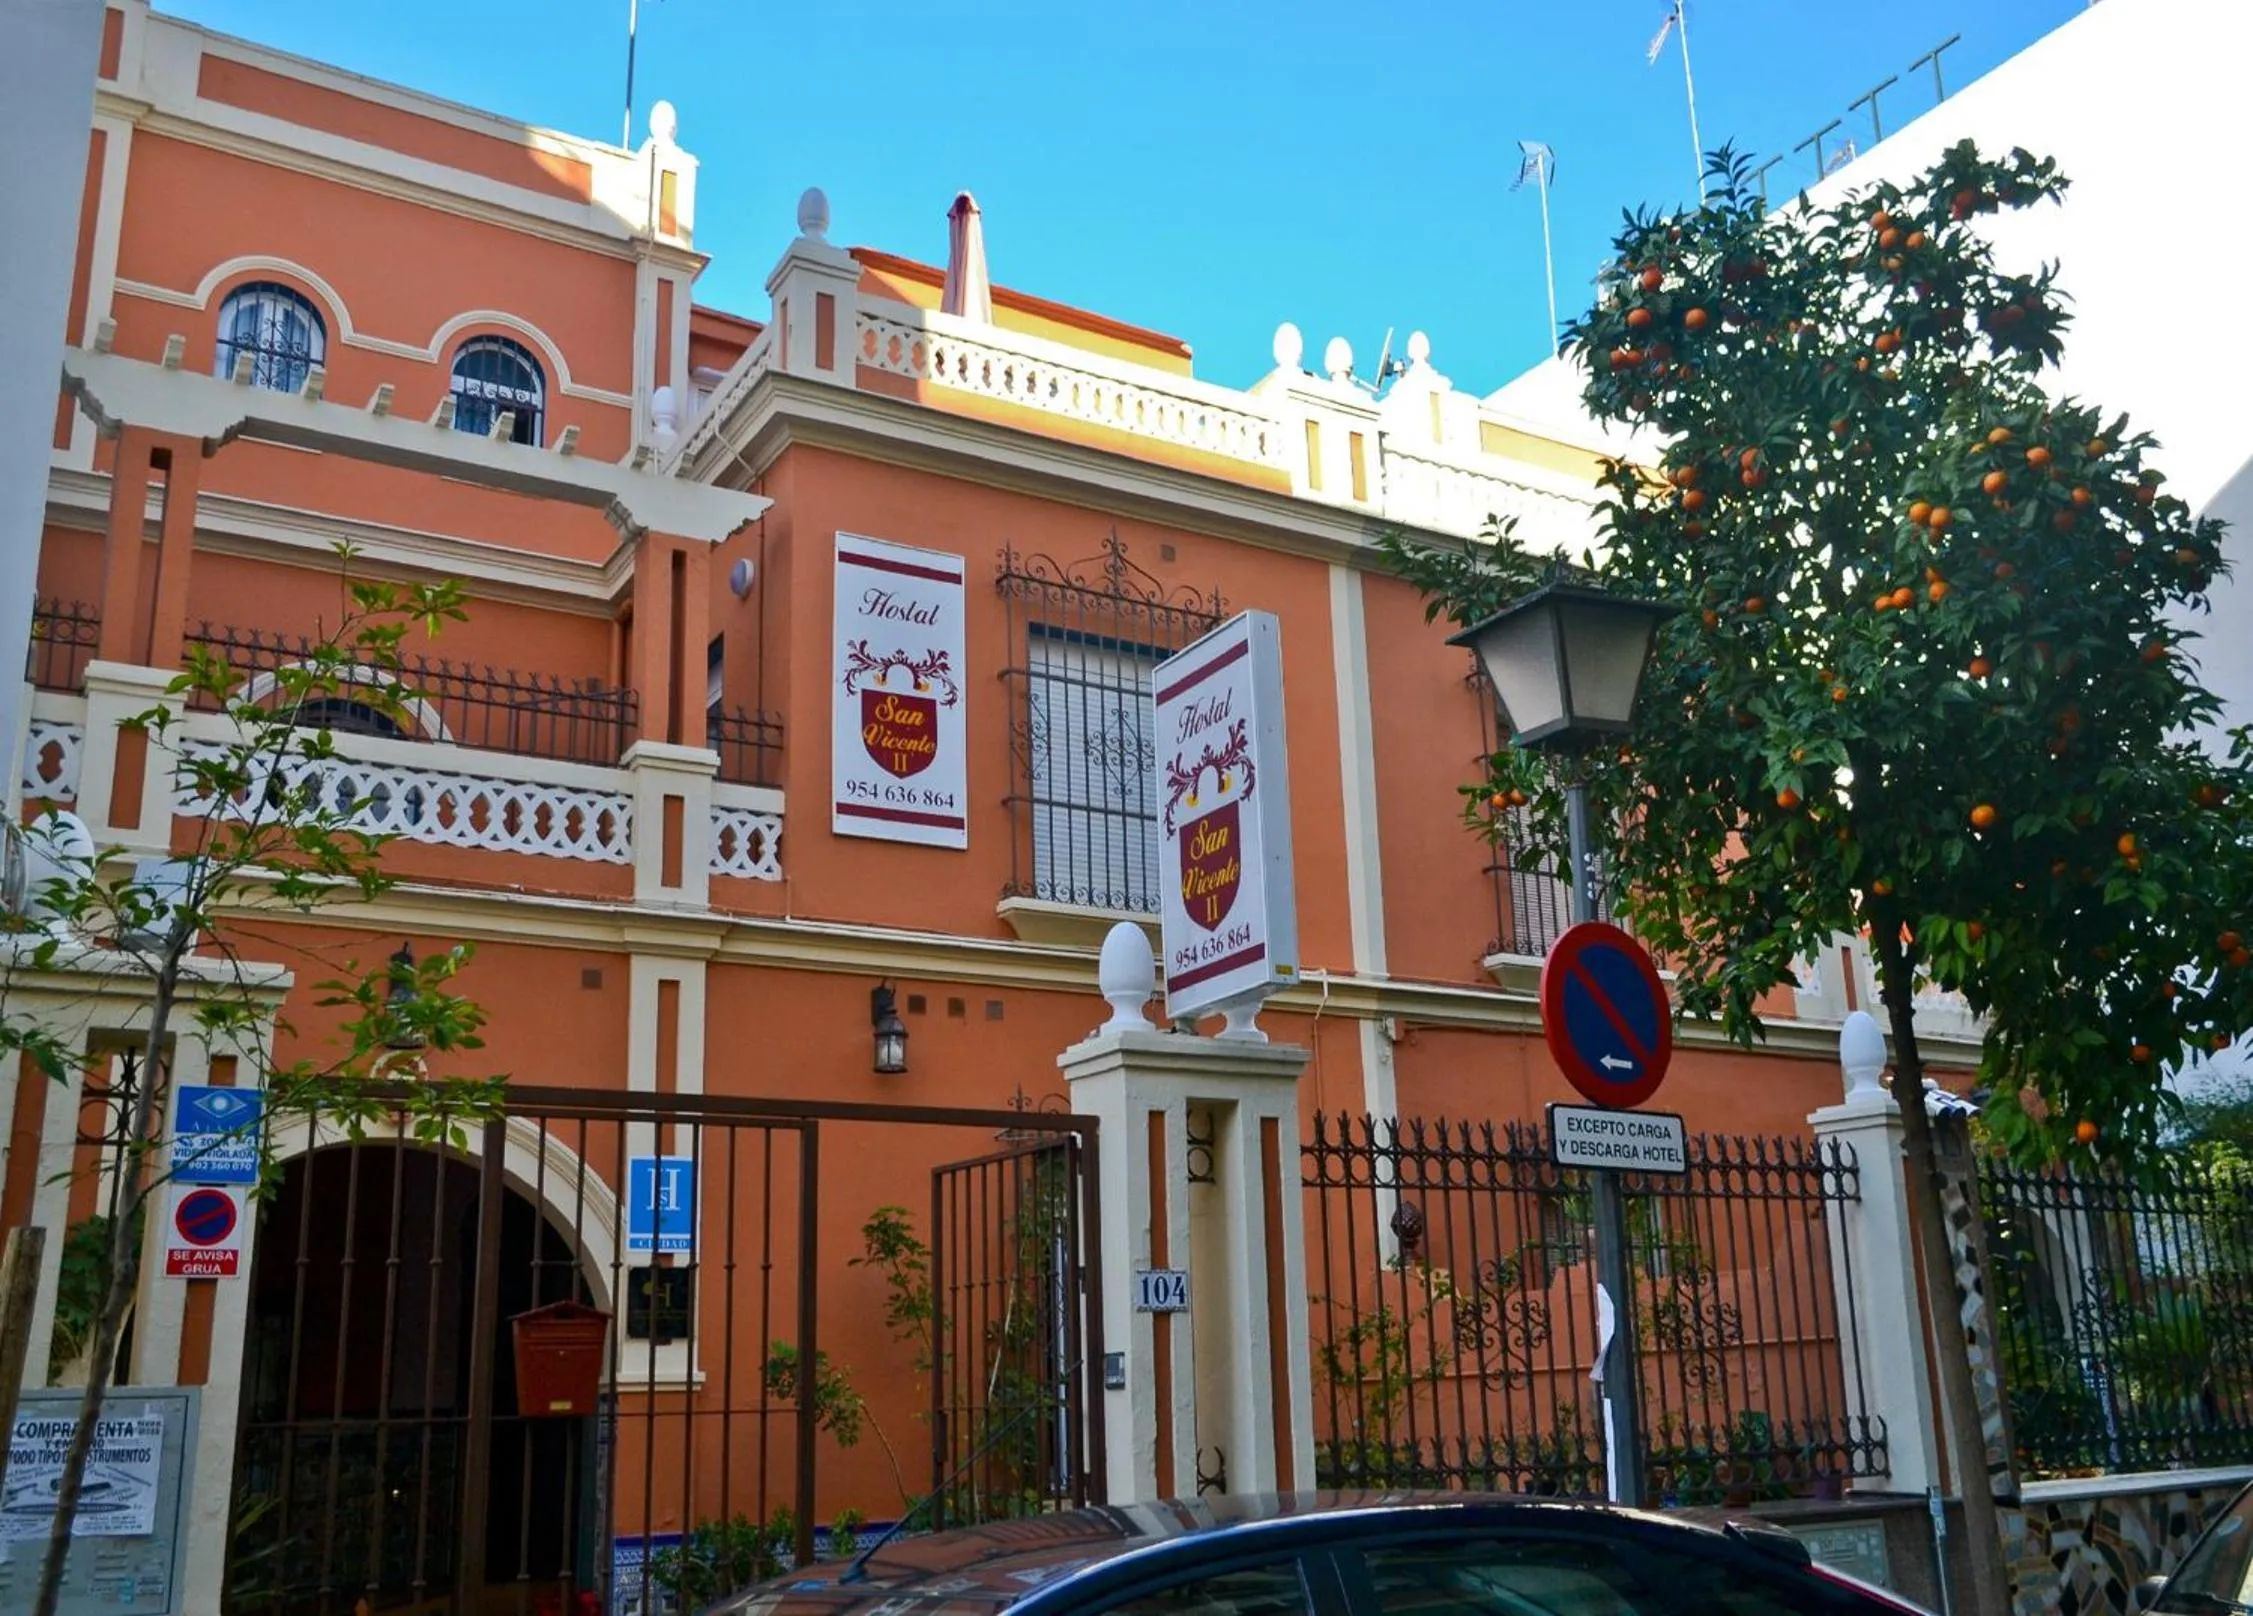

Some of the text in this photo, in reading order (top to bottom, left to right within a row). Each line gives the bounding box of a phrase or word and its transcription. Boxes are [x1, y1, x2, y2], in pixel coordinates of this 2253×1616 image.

[858, 587, 940, 626] Hostal
[875, 695, 926, 726] San
[1176, 687, 1233, 744] Hostal
[863, 722, 936, 755] Vicente
[893, 754, 908, 772] II
[846, 780, 955, 809] 954 636 864
[1190, 818, 1229, 861] San
[1182, 855, 1240, 900] Vicente
[1205, 893, 1220, 924] II
[1175, 924, 1251, 971] 954 636 864
[1568, 1117, 1672, 1139] EXCEPTO CARGA
[1560, 1140, 1682, 1162] Y DESCARGA HOTEL
[173, 1250, 234, 1261] SE AVISA
[638, 1239, 688, 1248] CIDAD
[182, 1263, 221, 1274] GRUA
[1142, 1275, 1185, 1304] 104
[96, 1421, 134, 1437] ENTA
[38, 1448, 61, 1464] TIPO
